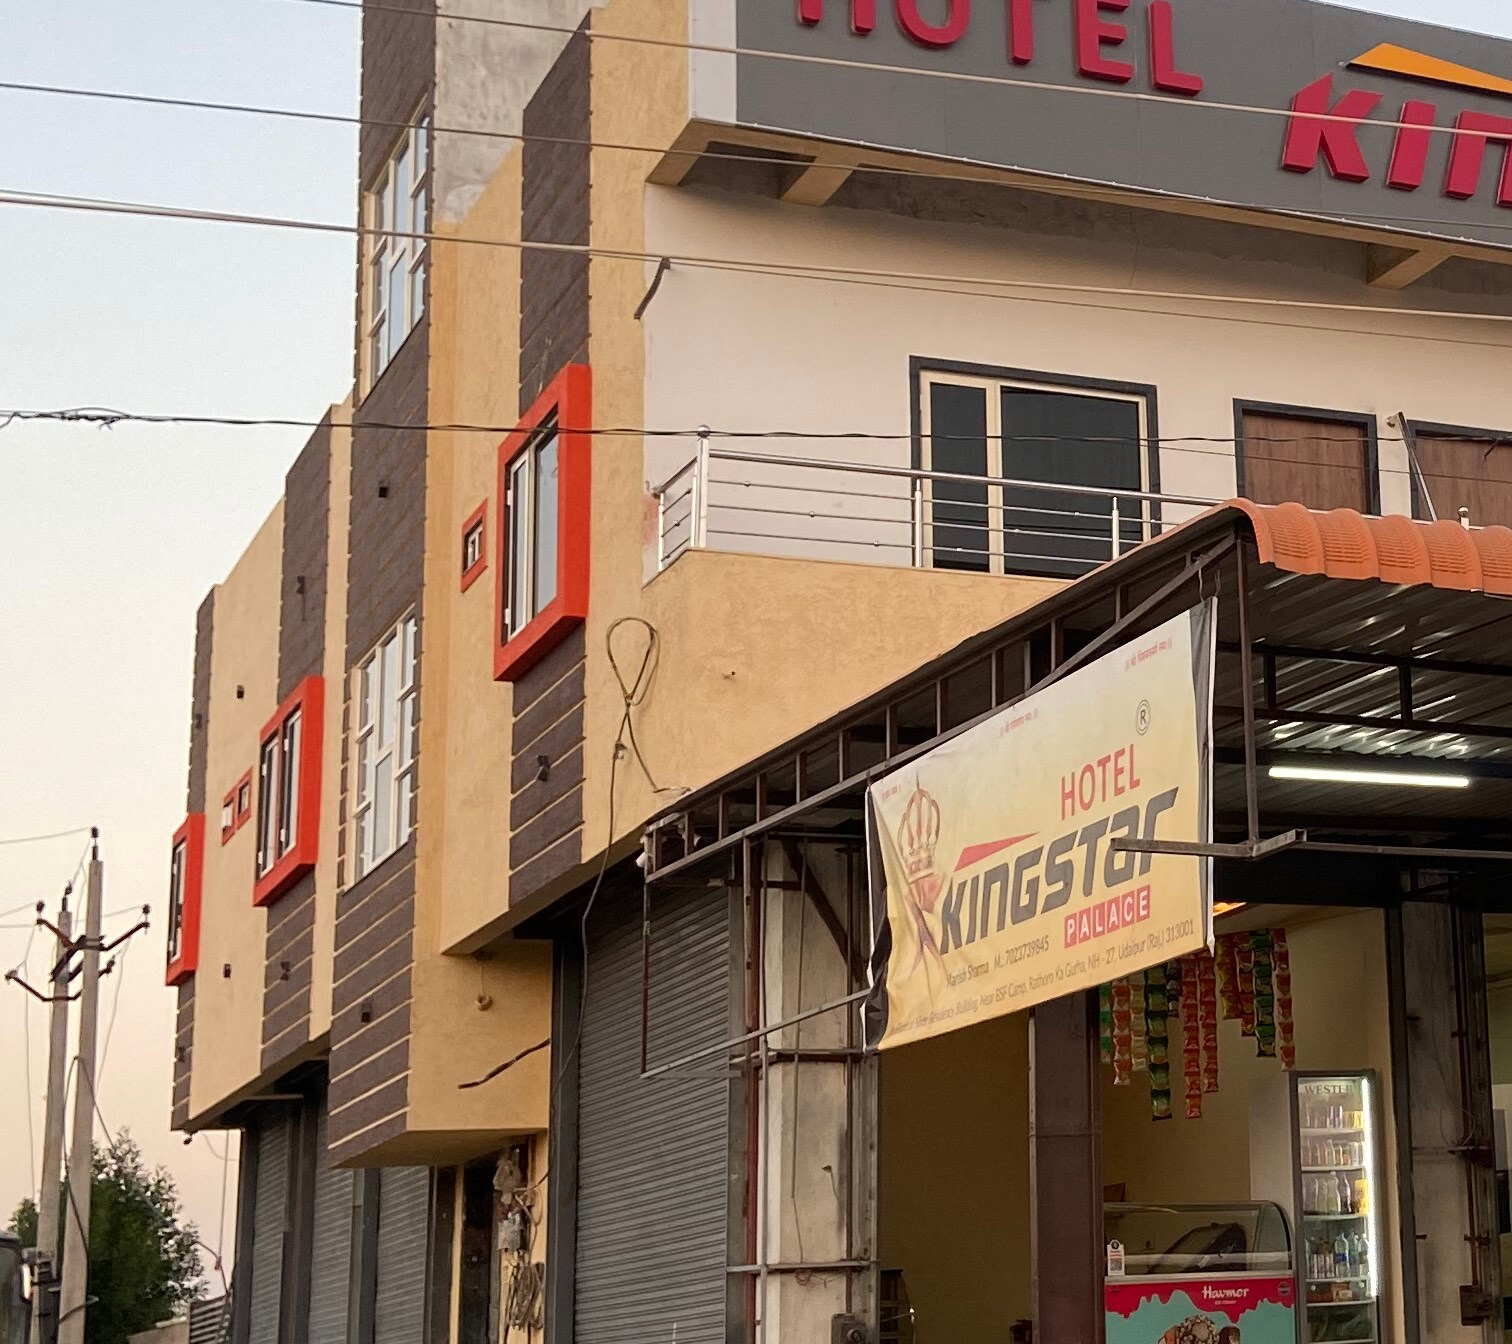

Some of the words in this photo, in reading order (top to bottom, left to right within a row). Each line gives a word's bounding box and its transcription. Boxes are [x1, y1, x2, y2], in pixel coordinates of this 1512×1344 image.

[1060, 743, 1141, 821] HOTEL
[1065, 887, 1150, 945] PALACE
[1087, 953, 1100, 972] NH
[1165, 918, 1195, 945] 313001
[1201, 1284, 1250, 1300] Havmor
